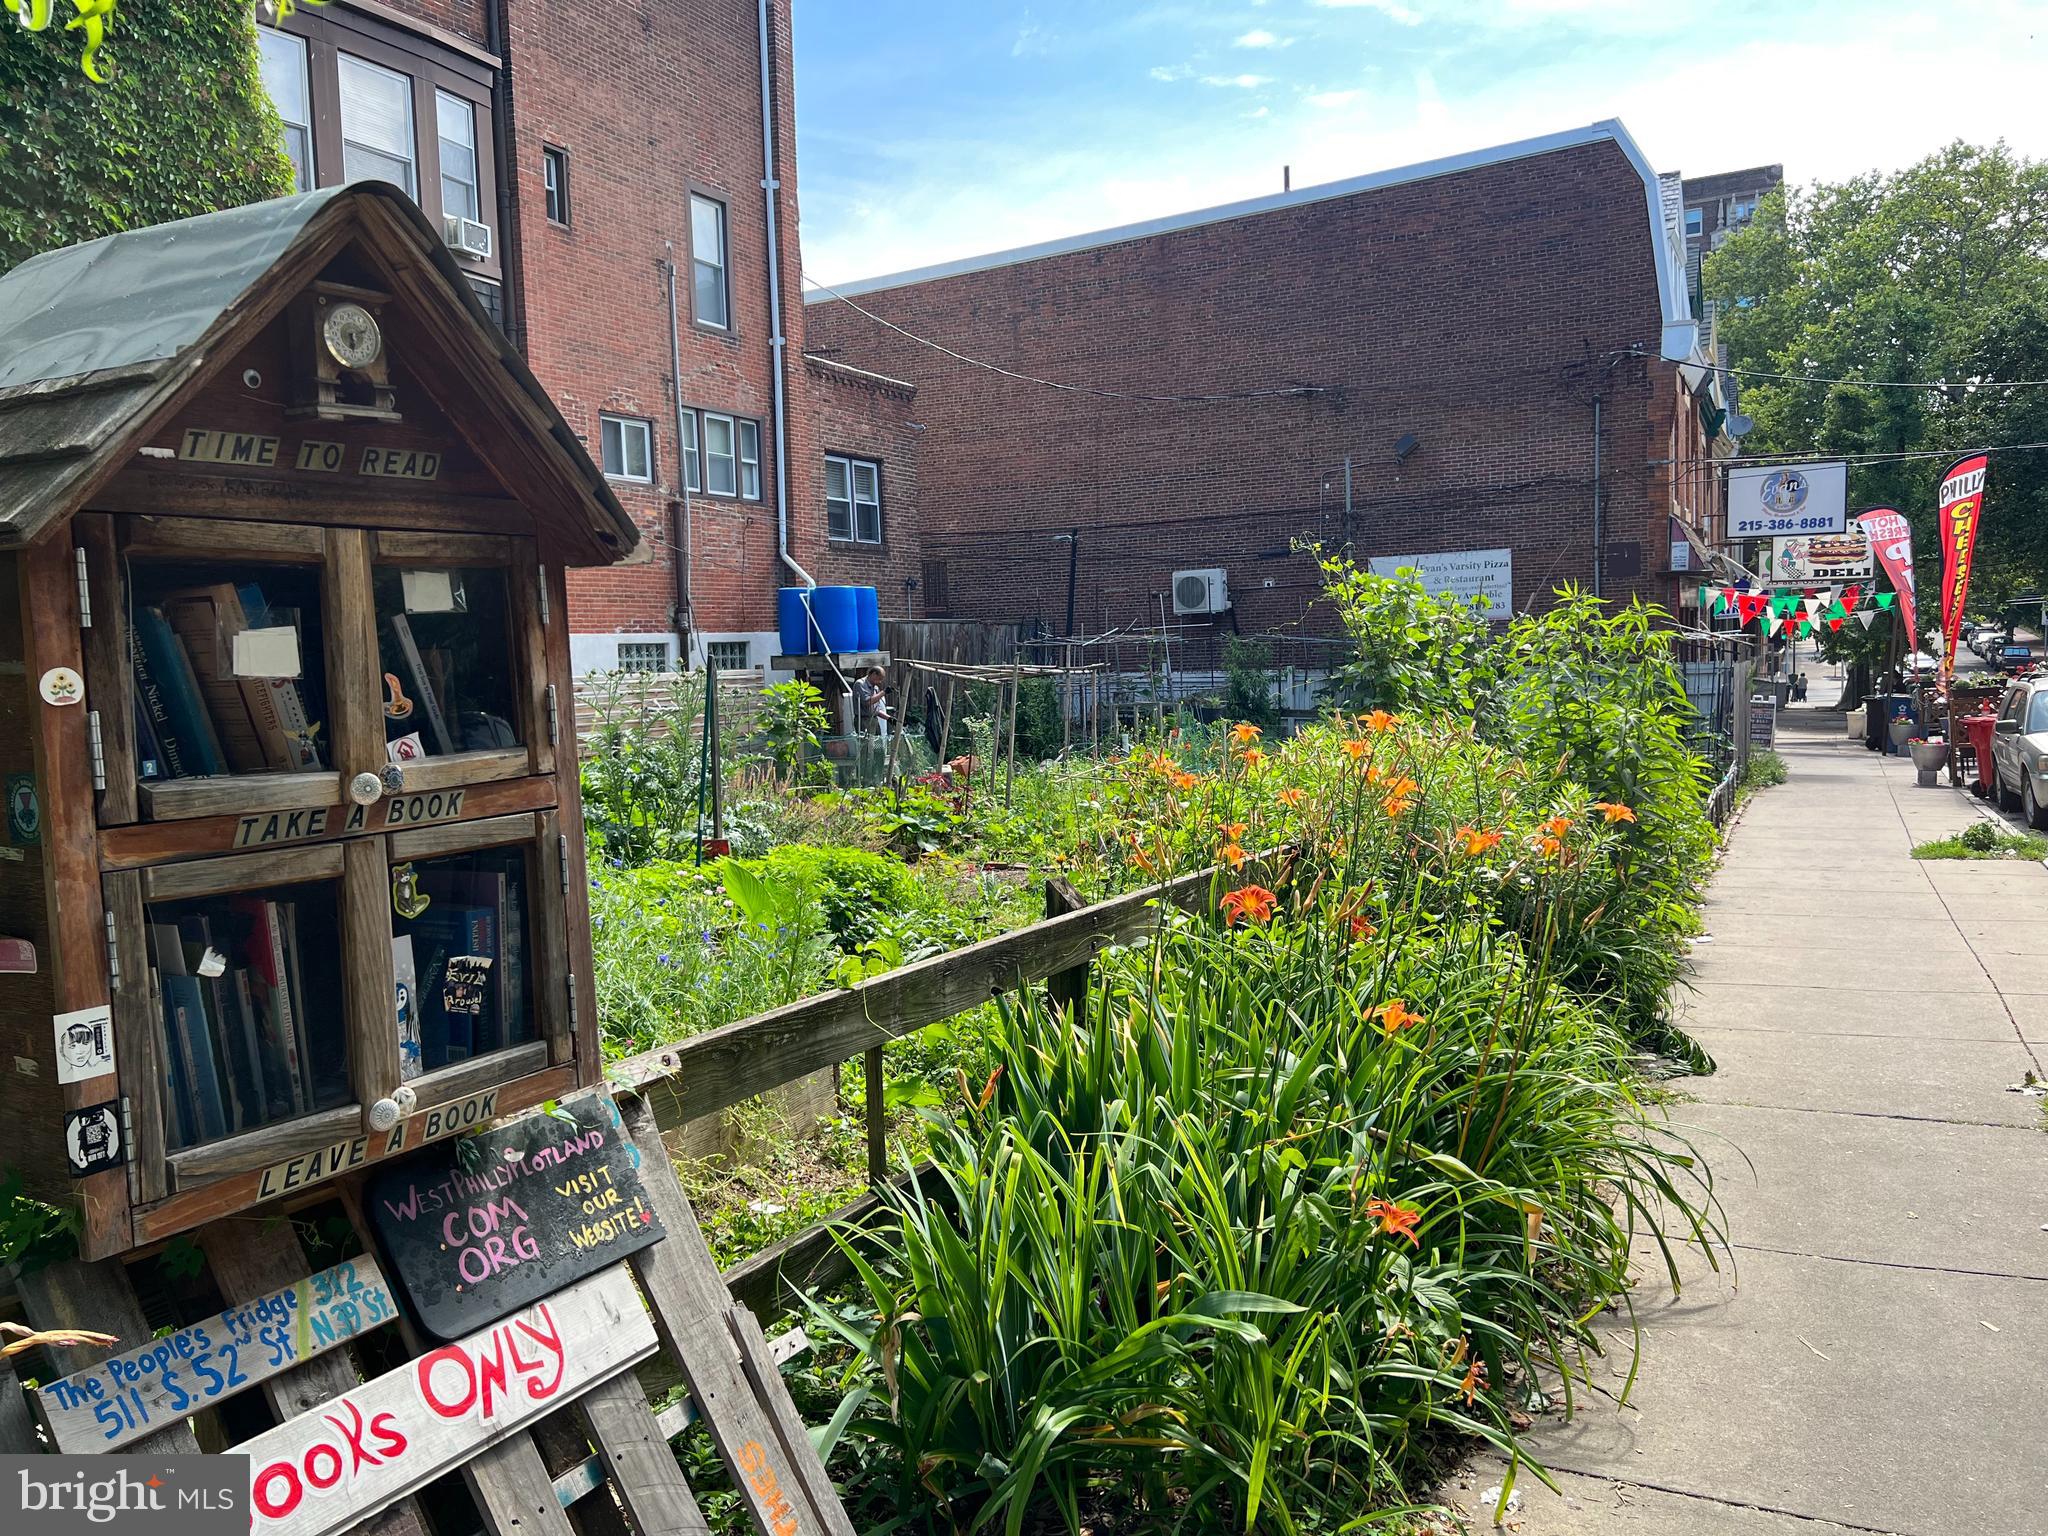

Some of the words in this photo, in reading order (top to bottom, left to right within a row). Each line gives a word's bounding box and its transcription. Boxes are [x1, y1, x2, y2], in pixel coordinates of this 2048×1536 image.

[187, 431, 277, 464] TIME
[303, 443, 340, 469] TO
[362, 449, 437, 477] READ
[1941, 472, 1985, 504] PHILLY
[1738, 517, 1833, 532] 215-386-8881
[1433, 577, 1441, 585] &
[1444, 574, 1494, 584] Restaurant
[1450, 561, 1481, 571] Varsity
[1484, 560, 1508, 569] Pizza
[1813, 567, 1871, 578] DELI
[145, 682, 169, 723] Nickel
[252, 678, 278, 731] IZEFIGHTERS
[241, 809, 327, 845] TAKE
[348, 804, 364, 829] A
[389, 792, 462, 823] BOOK
[260, 1136, 368, 1199] LEAVE
[387, 1125, 403, 1152] A
[425, 1093, 498, 1138] BOOK
[555, 1164, 615, 1198] VISIT
[582, 1188, 623, 1215] OUR
[568, 1196, 644, 1250] WEBSITE!
[309, 1262, 365, 1306] 312
[45, 1379, 104, 1411] The
[106, 1326, 211, 1389] People's
[221, 1288, 298, 1335] Fridge
[93, 1387, 149, 1439] 511
